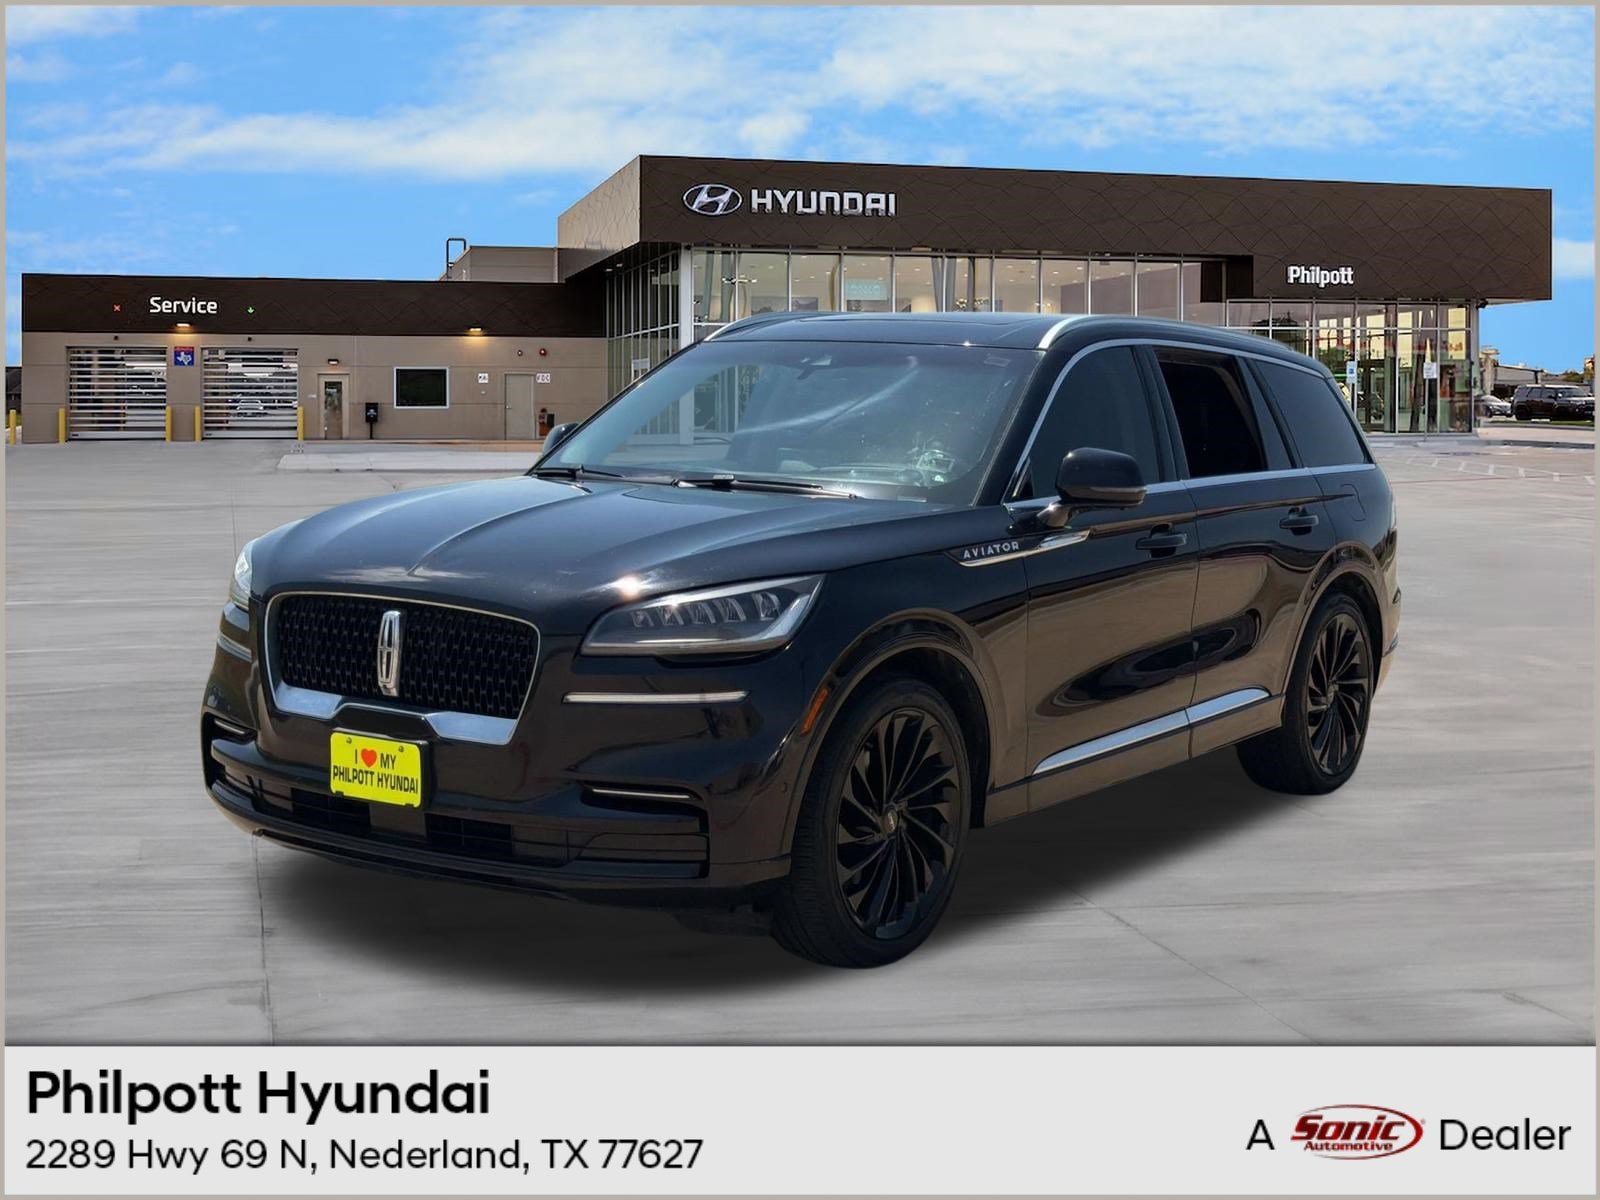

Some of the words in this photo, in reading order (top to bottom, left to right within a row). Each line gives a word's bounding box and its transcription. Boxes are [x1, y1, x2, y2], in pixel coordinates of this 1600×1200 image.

[751, 189, 896, 216] HYUNDAI
[1287, 266, 1354, 288] Philpott
[149, 296, 218, 314] Service
[963, 541, 1020, 559] AVIATOR
[380, 752, 397, 770] MY
[333, 765, 375, 787] PHILPOTT
[377, 772, 419, 794] HYUNDAI
